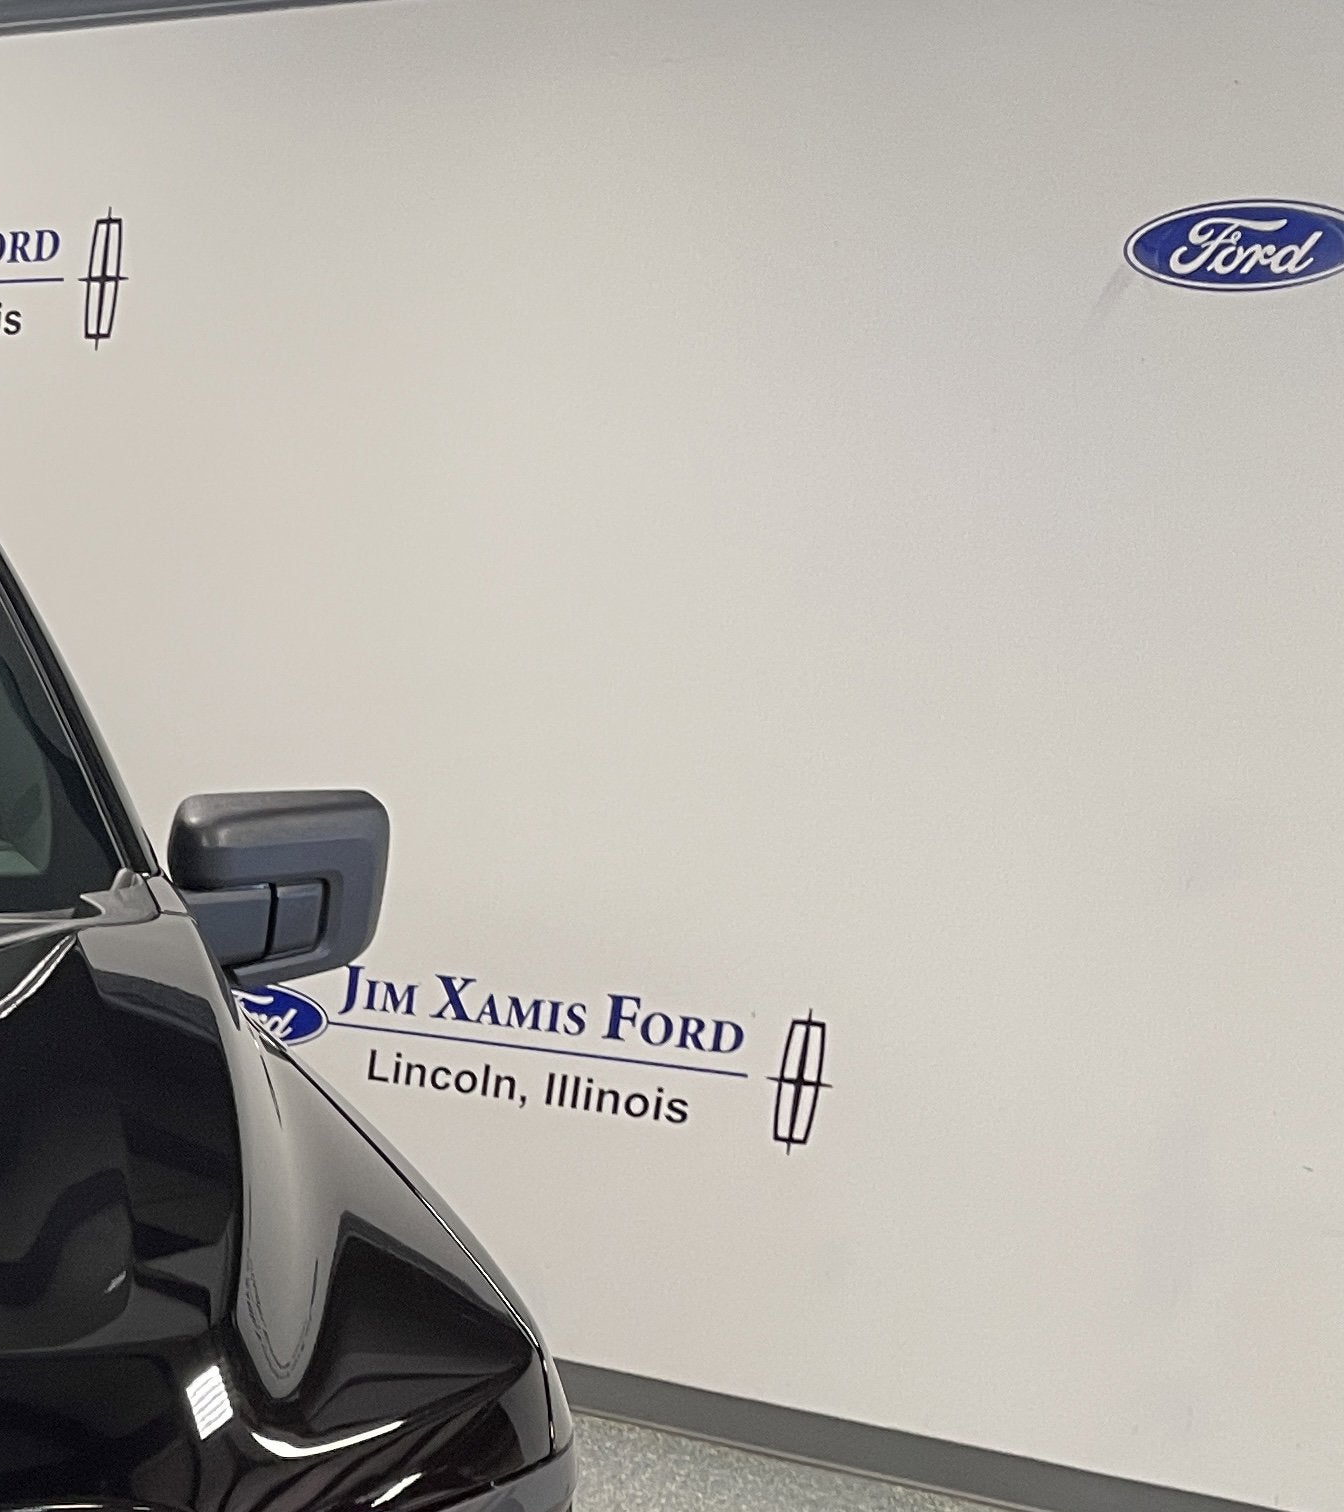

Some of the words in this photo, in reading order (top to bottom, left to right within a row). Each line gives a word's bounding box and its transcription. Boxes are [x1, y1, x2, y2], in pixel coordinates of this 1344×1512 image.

[1169, 217, 1323, 275] Ford
[337, 965, 419, 1016] JIM
[429, 974, 588, 1036] XAMIS
[601, 994, 746, 1056] FORD
[367, 1049, 528, 1108] Lincoln,
[545, 1071, 690, 1125] Illinois
